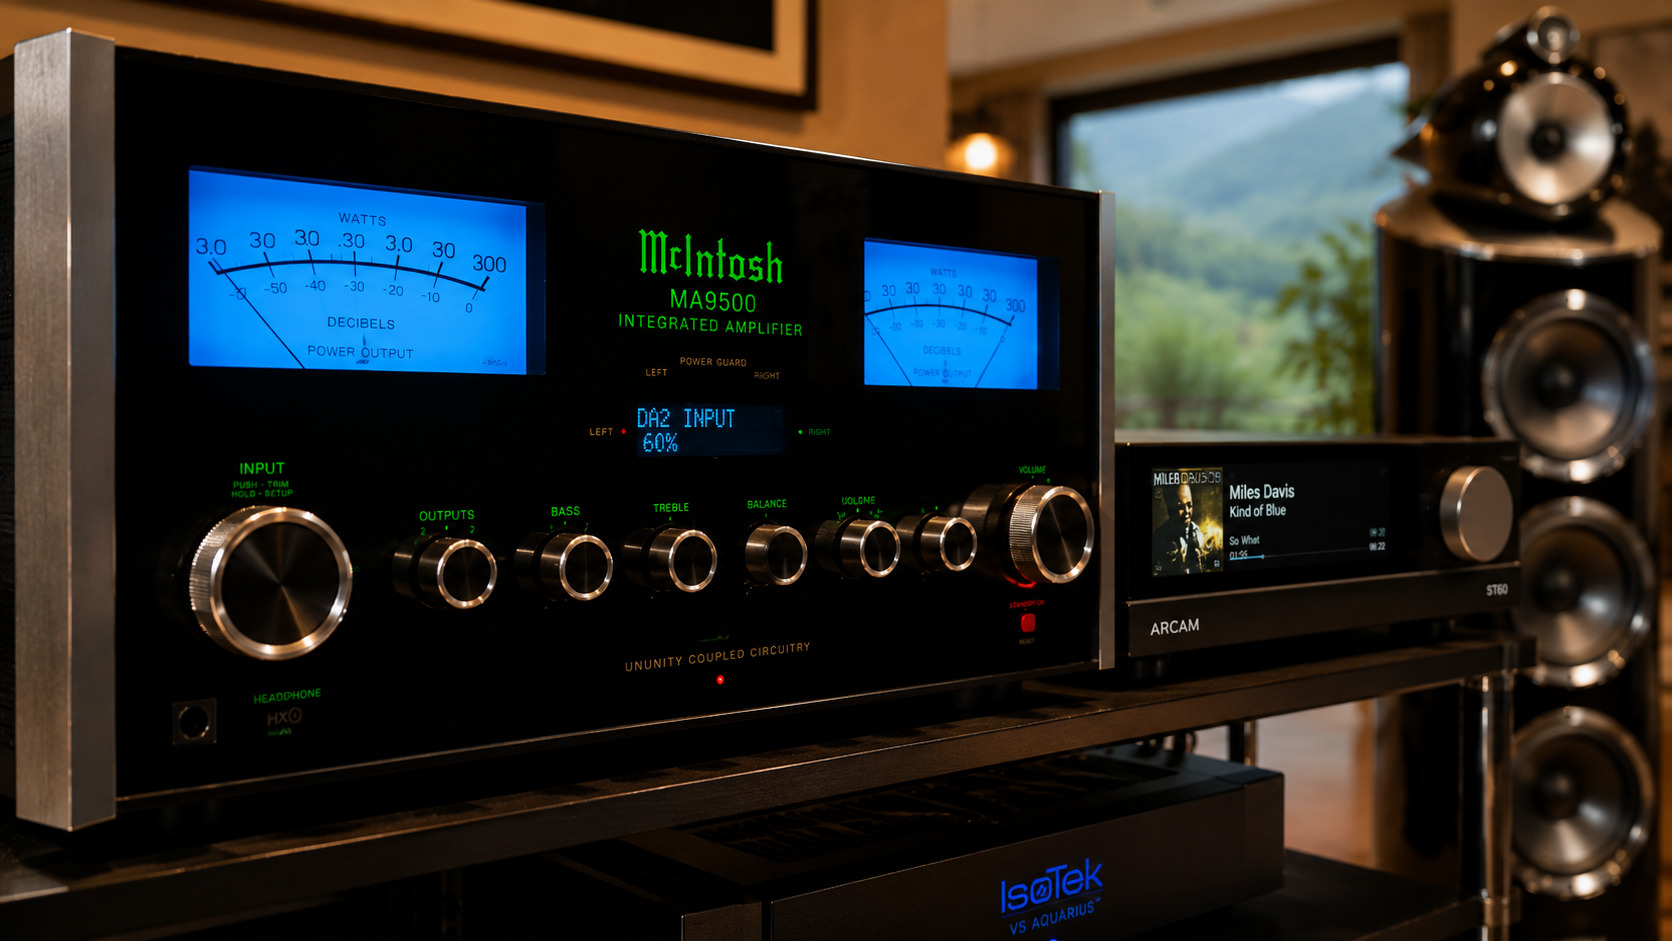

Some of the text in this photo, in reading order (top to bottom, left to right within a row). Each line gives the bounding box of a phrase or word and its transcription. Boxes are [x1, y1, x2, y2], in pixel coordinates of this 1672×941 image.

[338, 211, 387, 227] WATTS
[196, 237, 227, 256] 3.0
[249, 231, 276, 249] 30
[385, 234, 413, 253] 3.0
[432, 241, 456, 259] 30
[472, 254, 507, 273] 300
[638, 228, 783, 284] McIntosh
[930, 267, 957, 279] WATTS
[263, 281, 288, 294] -50
[304, 279, 326, 292] -40
[344, 280, 365, 292] -30
[382, 284, 404, 297] -20
[421, 291, 440, 303] -10
[465, 302, 473, 313] 0
[670, 288, 756, 313] MA9500
[1006, 297, 1026, 313] 300
[327, 316, 395, 330] DECIBELS
[619, 313, 802, 336] INTEGRATED AMPLIFIER
[308, 344, 414, 359] POWER OUTPUT
[680, 356, 747, 367] POWER GUARD
[645, 368, 668, 377] LEFT
[637, 407, 735, 428] DA2 INPUT
[589, 427, 613, 436] LEFT
[808, 428, 831, 436] RIGHT
[643, 432, 678, 453] 60%
[240, 461, 285, 475] INPUT
[1018, 465, 1047, 474] VOLUME
[1229, 483, 1295, 500] Miles Davis
[653, 502, 689, 513] TREBLE
[747, 498, 787, 509] BALANCE
[1229, 503, 1287, 518] Kind of Blue
[419, 509, 475, 522] OUTPUTS
[551, 506, 581, 517] BASS
[1229, 535, 1240, 546] So
[1486, 583, 1509, 596] ST60
[1150, 617, 1200, 636] ARCAM
[625, 641, 811, 672] UNUNITY COUPLED CIRCUITRY
[1001, 857, 1103, 914] IsoTek
[1009, 900, 1095, 936] VS AQUARIUS
